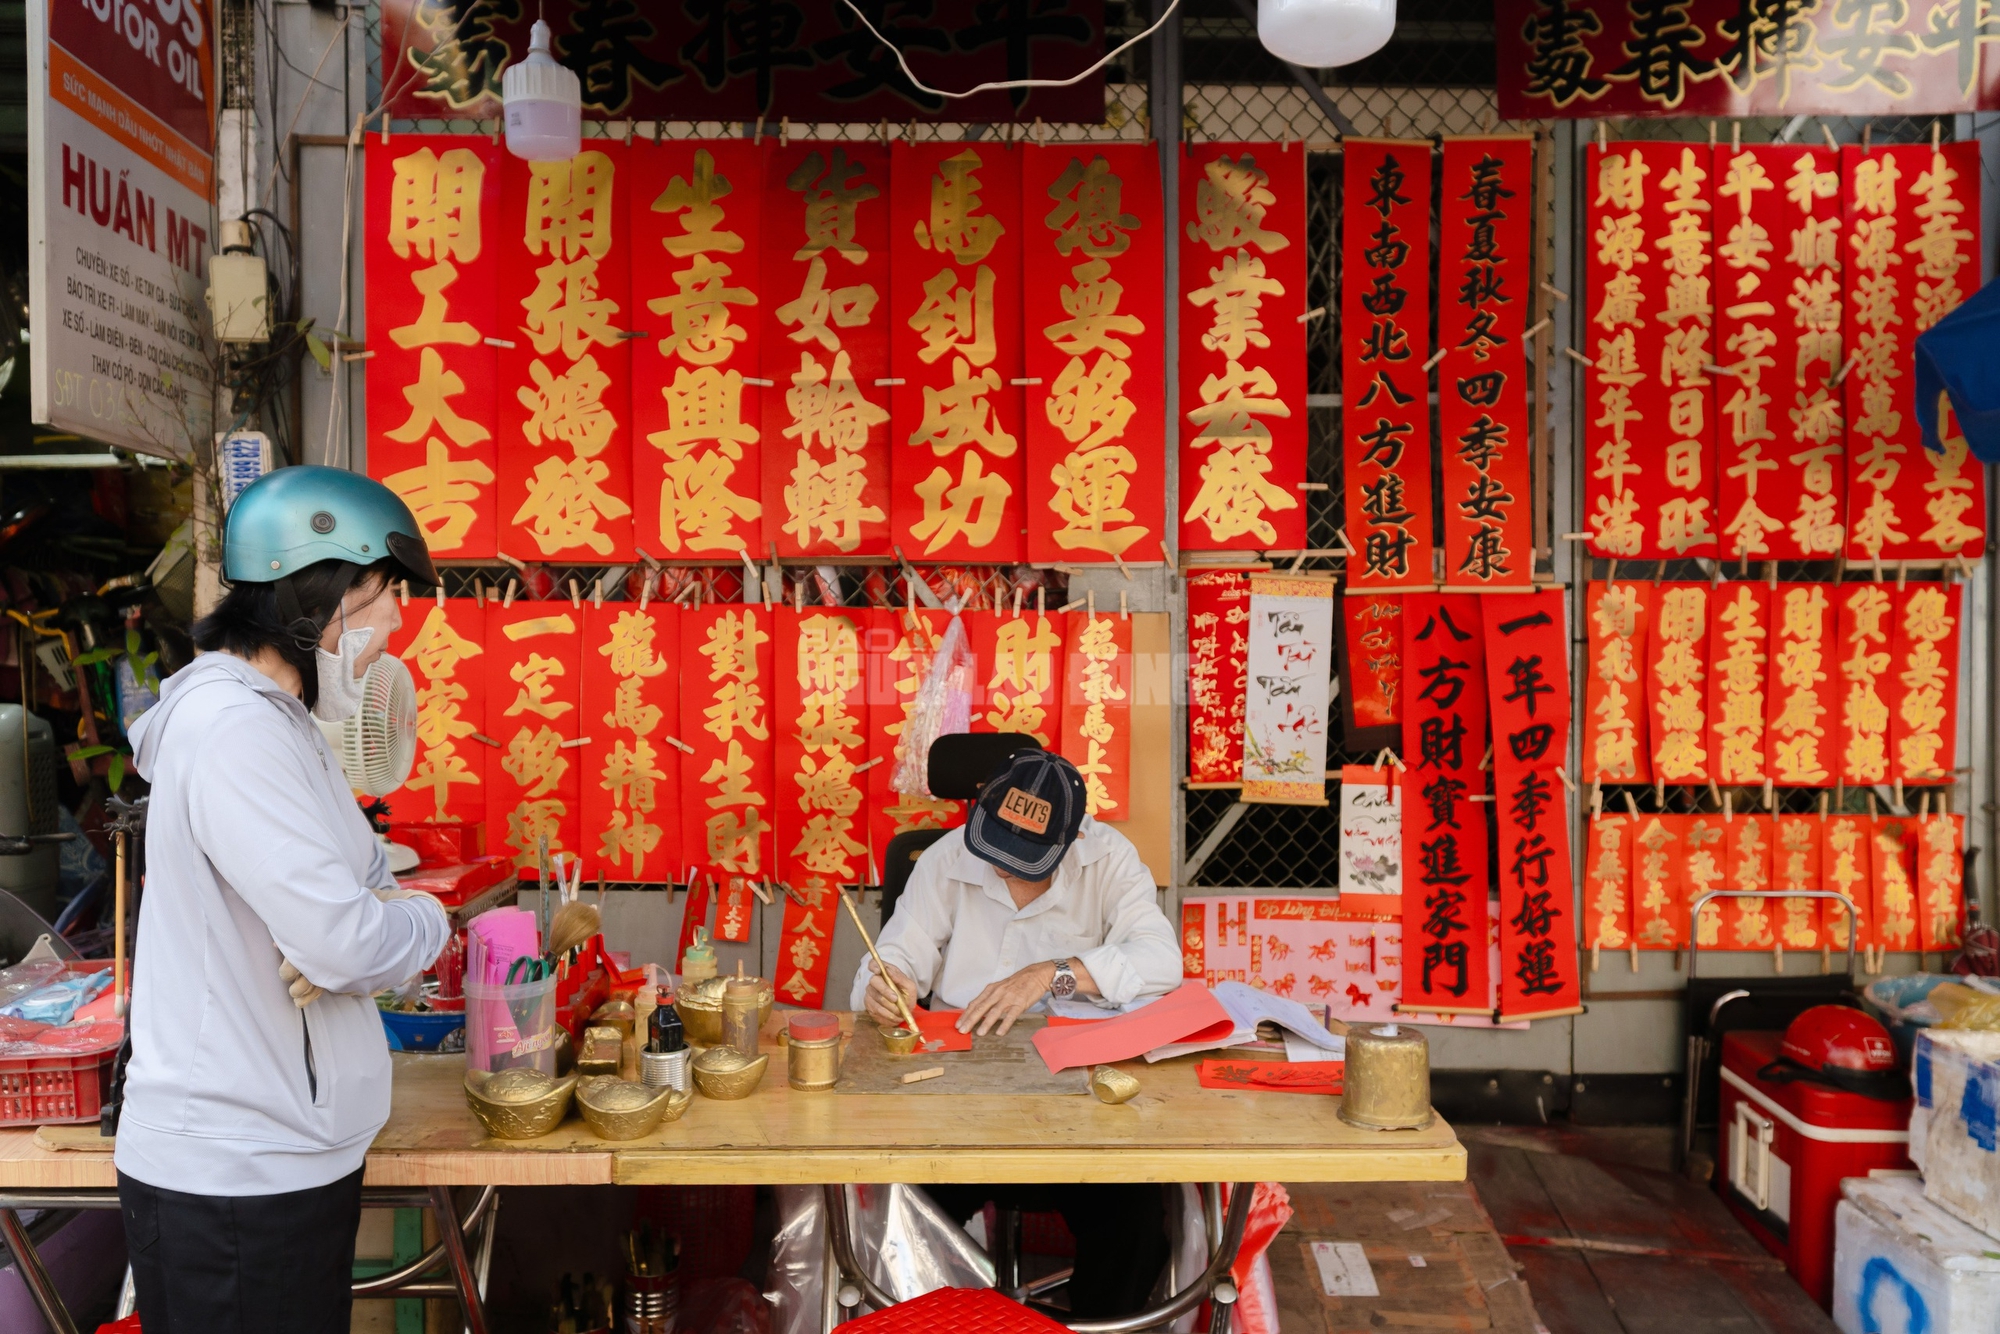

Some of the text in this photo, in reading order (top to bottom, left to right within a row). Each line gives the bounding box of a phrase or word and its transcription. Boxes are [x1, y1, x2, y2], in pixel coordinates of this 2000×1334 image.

[62, 72, 87, 101] SỨC
[88, 92, 116, 123] MẠNH
[82, 0, 160, 67] OTOR
[167, 40, 203, 100] OIL
[62, 143, 206, 280] HUẤN MT
[382, 147, 495, 552] 開工大吉
[512, 151, 631, 555] 開張鴻發
[646, 148, 762, 553] 生意興隆
[775, 147, 891, 552] 貨如輪轉
[908, 148, 1017, 556] 馬到成功
[1354, 153, 1418, 579] 東南西北八方進財
[1455, 152, 1516, 579] 春夏秋冬四季安康
[1589, 148, 1650, 556] 財源廣進年年滿
[1655, 147, 1717, 555] 生意興隆日日旺
[1784, 152, 1845, 555] 和順滿門添百福
[597, 609, 668, 879] 龍馬精神
[699, 609, 771, 875] 對我生財
[790, 613, 868, 879] 開張鴻發
[1005, 791, 1049, 823] LEVI'S
[1414, 605, 1473, 998] 八方財寶進家門
[1499, 610, 1567, 997] 一年四季行好運
[1592, 585, 1644, 780] 對我生財
[1654, 587, 1707, 779] 開張鴻發
[1713, 585, 1767, 782] 生意興隆
[1771, 585, 1829, 784] 財源廣進
[1842, 585, 1892, 782] 貨如輪轉
[1638, 817, 1677, 946] 合家平安
